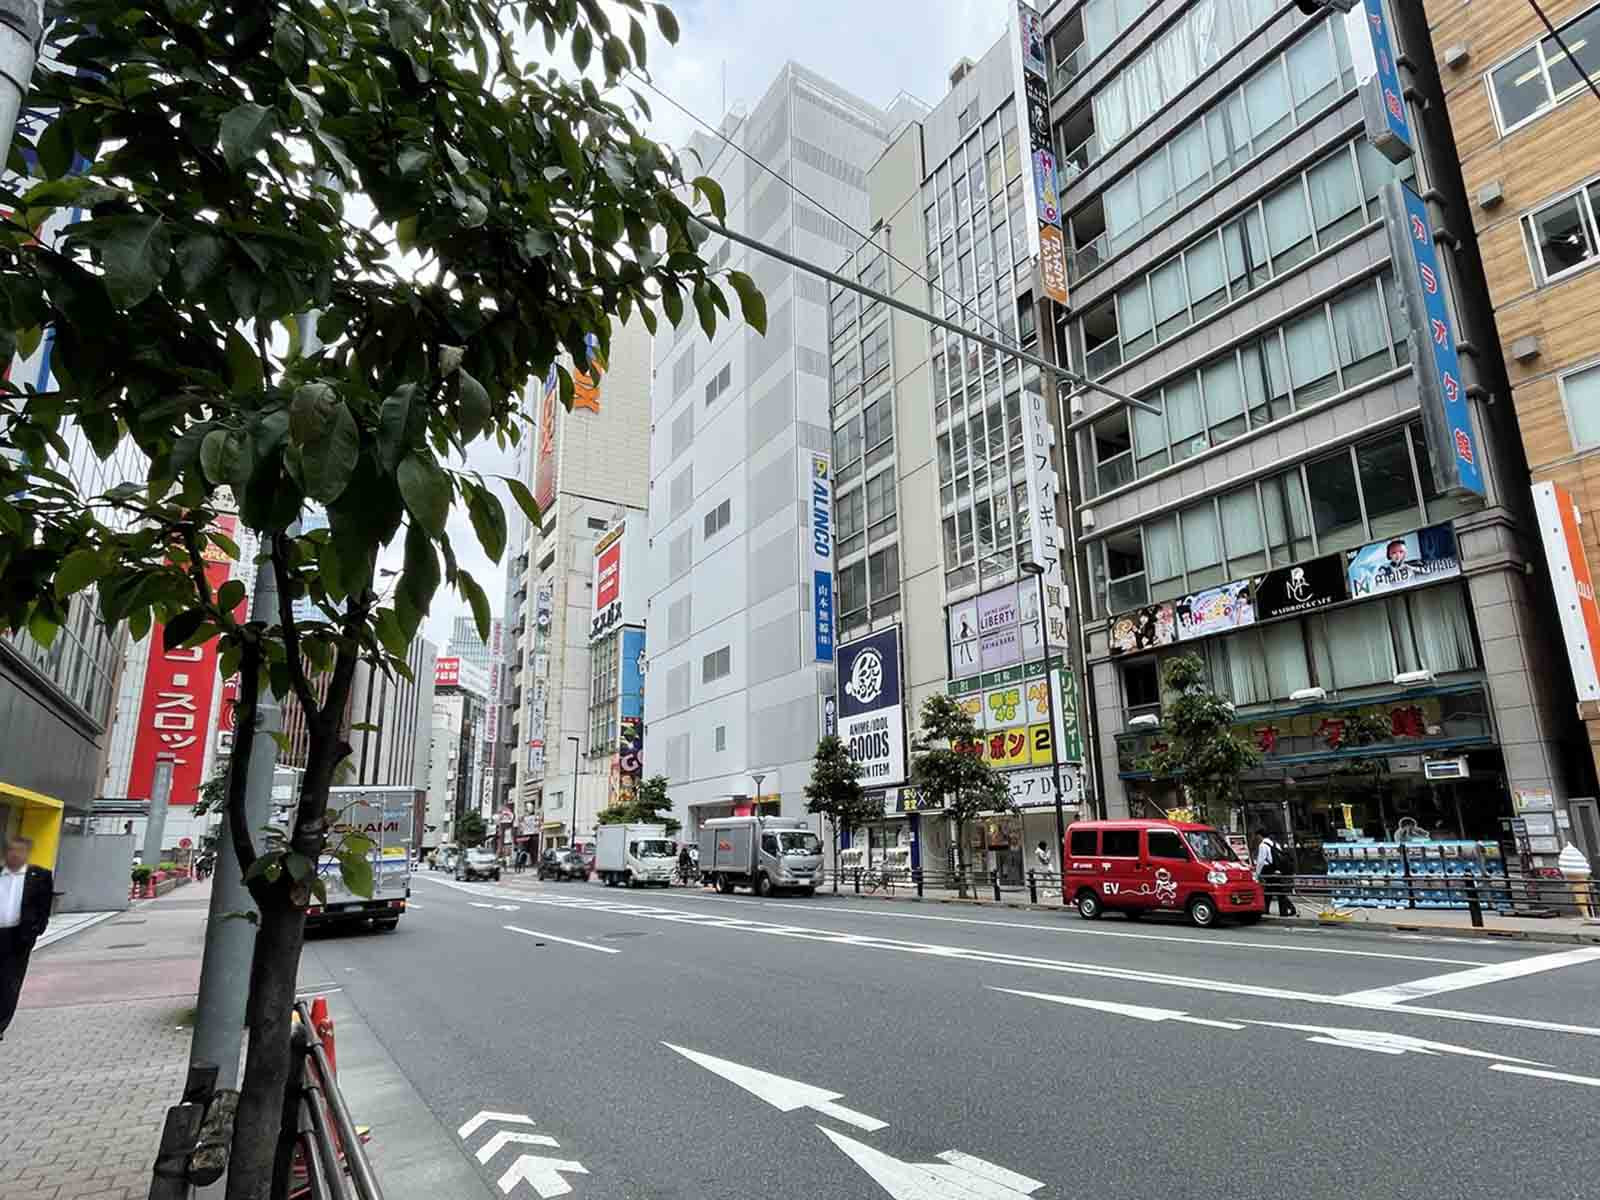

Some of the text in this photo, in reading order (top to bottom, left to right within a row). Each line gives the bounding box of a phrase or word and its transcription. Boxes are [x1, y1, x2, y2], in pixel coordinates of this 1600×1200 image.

[1411, 214, 1474, 464] カラオケ館
[813, 480, 831, 558] ALINCO
[981, 609, 1016, 630] LIBERTY
[849, 716, 889, 736] ANIME/IDOL
[1062, 675, 1078, 757] リバティー
[849, 730, 890, 762] GOODS
[872, 761, 891, 777] ITEM
[1103, 882, 1120, 895] EV
